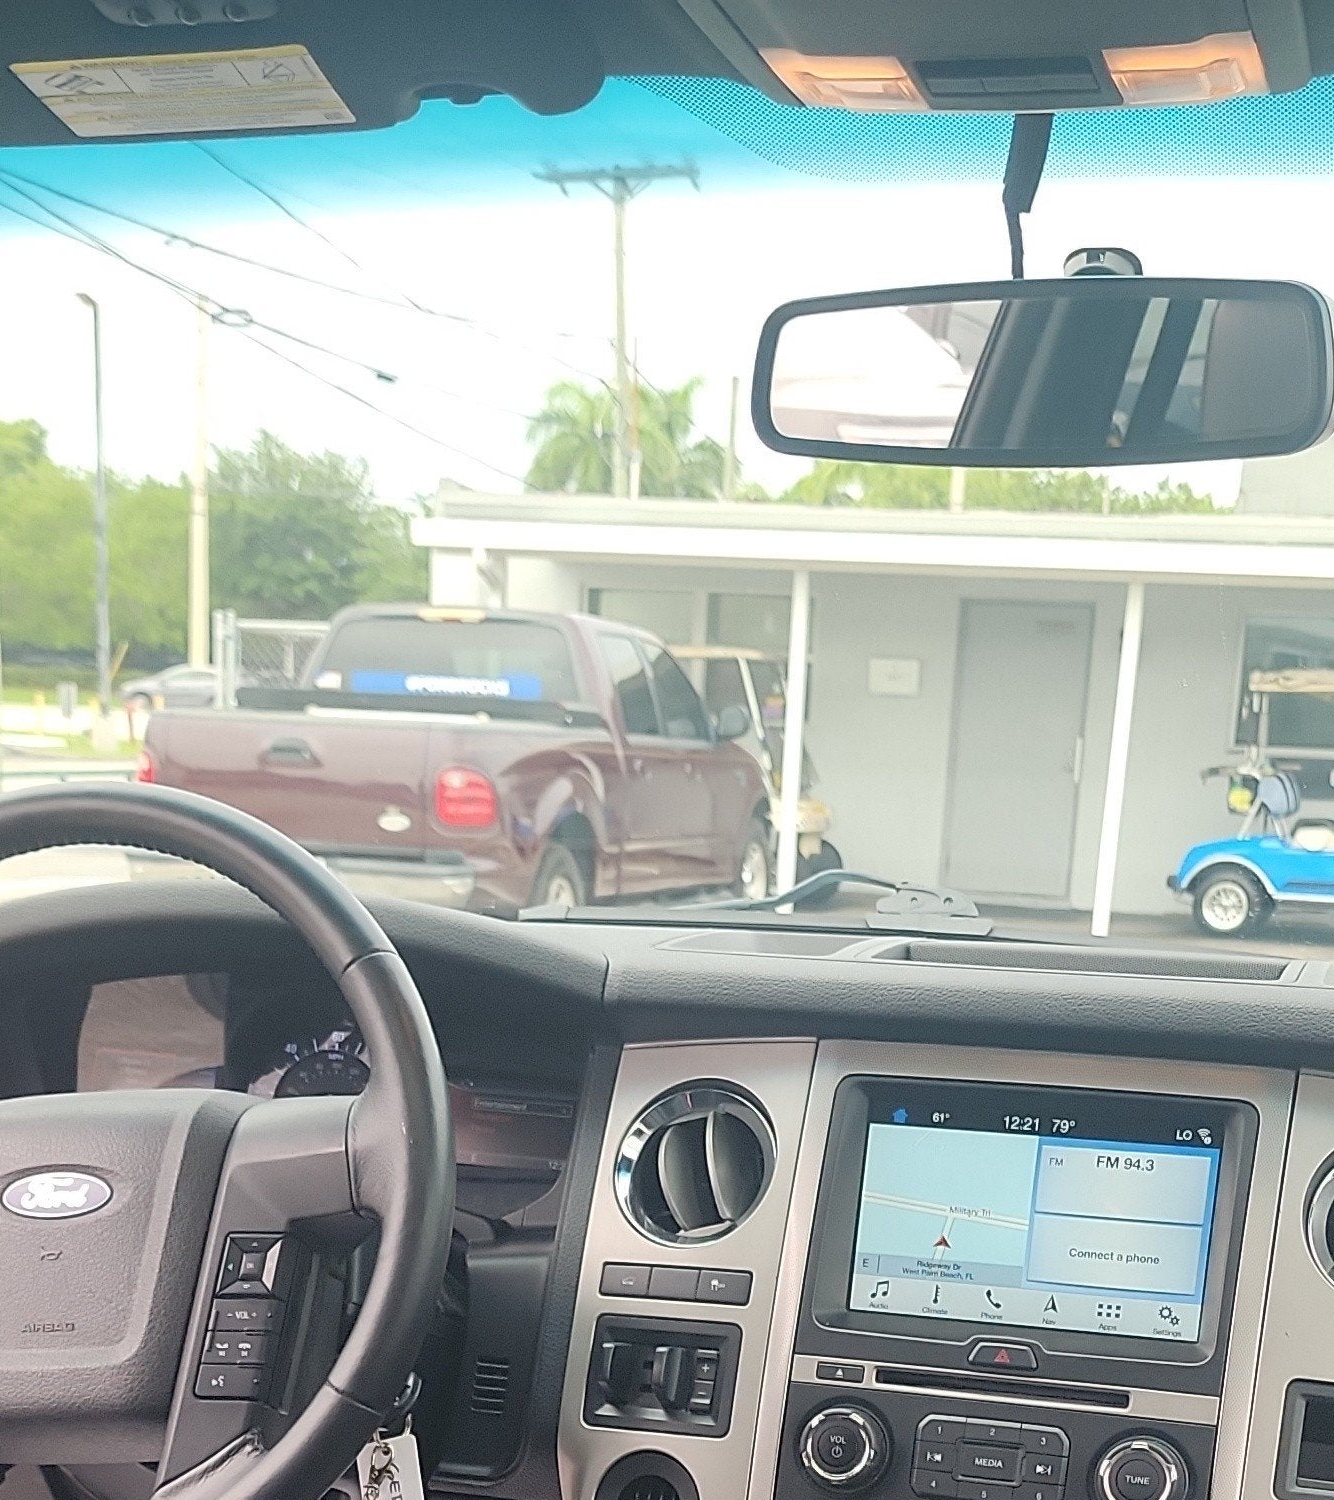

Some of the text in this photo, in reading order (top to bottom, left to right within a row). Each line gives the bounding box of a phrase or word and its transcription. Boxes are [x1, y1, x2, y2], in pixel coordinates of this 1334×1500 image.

[1003, 1116, 1040, 1132] 12:21
[1175, 1129, 1193, 1141] LO
[1049, 1158, 1064, 1167] FM
[1096, 1155, 1155, 1172] FM 94.3
[1069, 1248, 1160, 1265] Connect a phone
[862, 1258, 869, 1268] E
[1098, 1323, 1117, 1332] Apps
[989, 1428, 996, 1436] 2
[829, 1435, 847, 1445] VOL
[1040, 1437, 1047, 1445] 3
[974, 1457, 1004, 1469] MEDIA
[1125, 1474, 1150, 1485] TUNE
